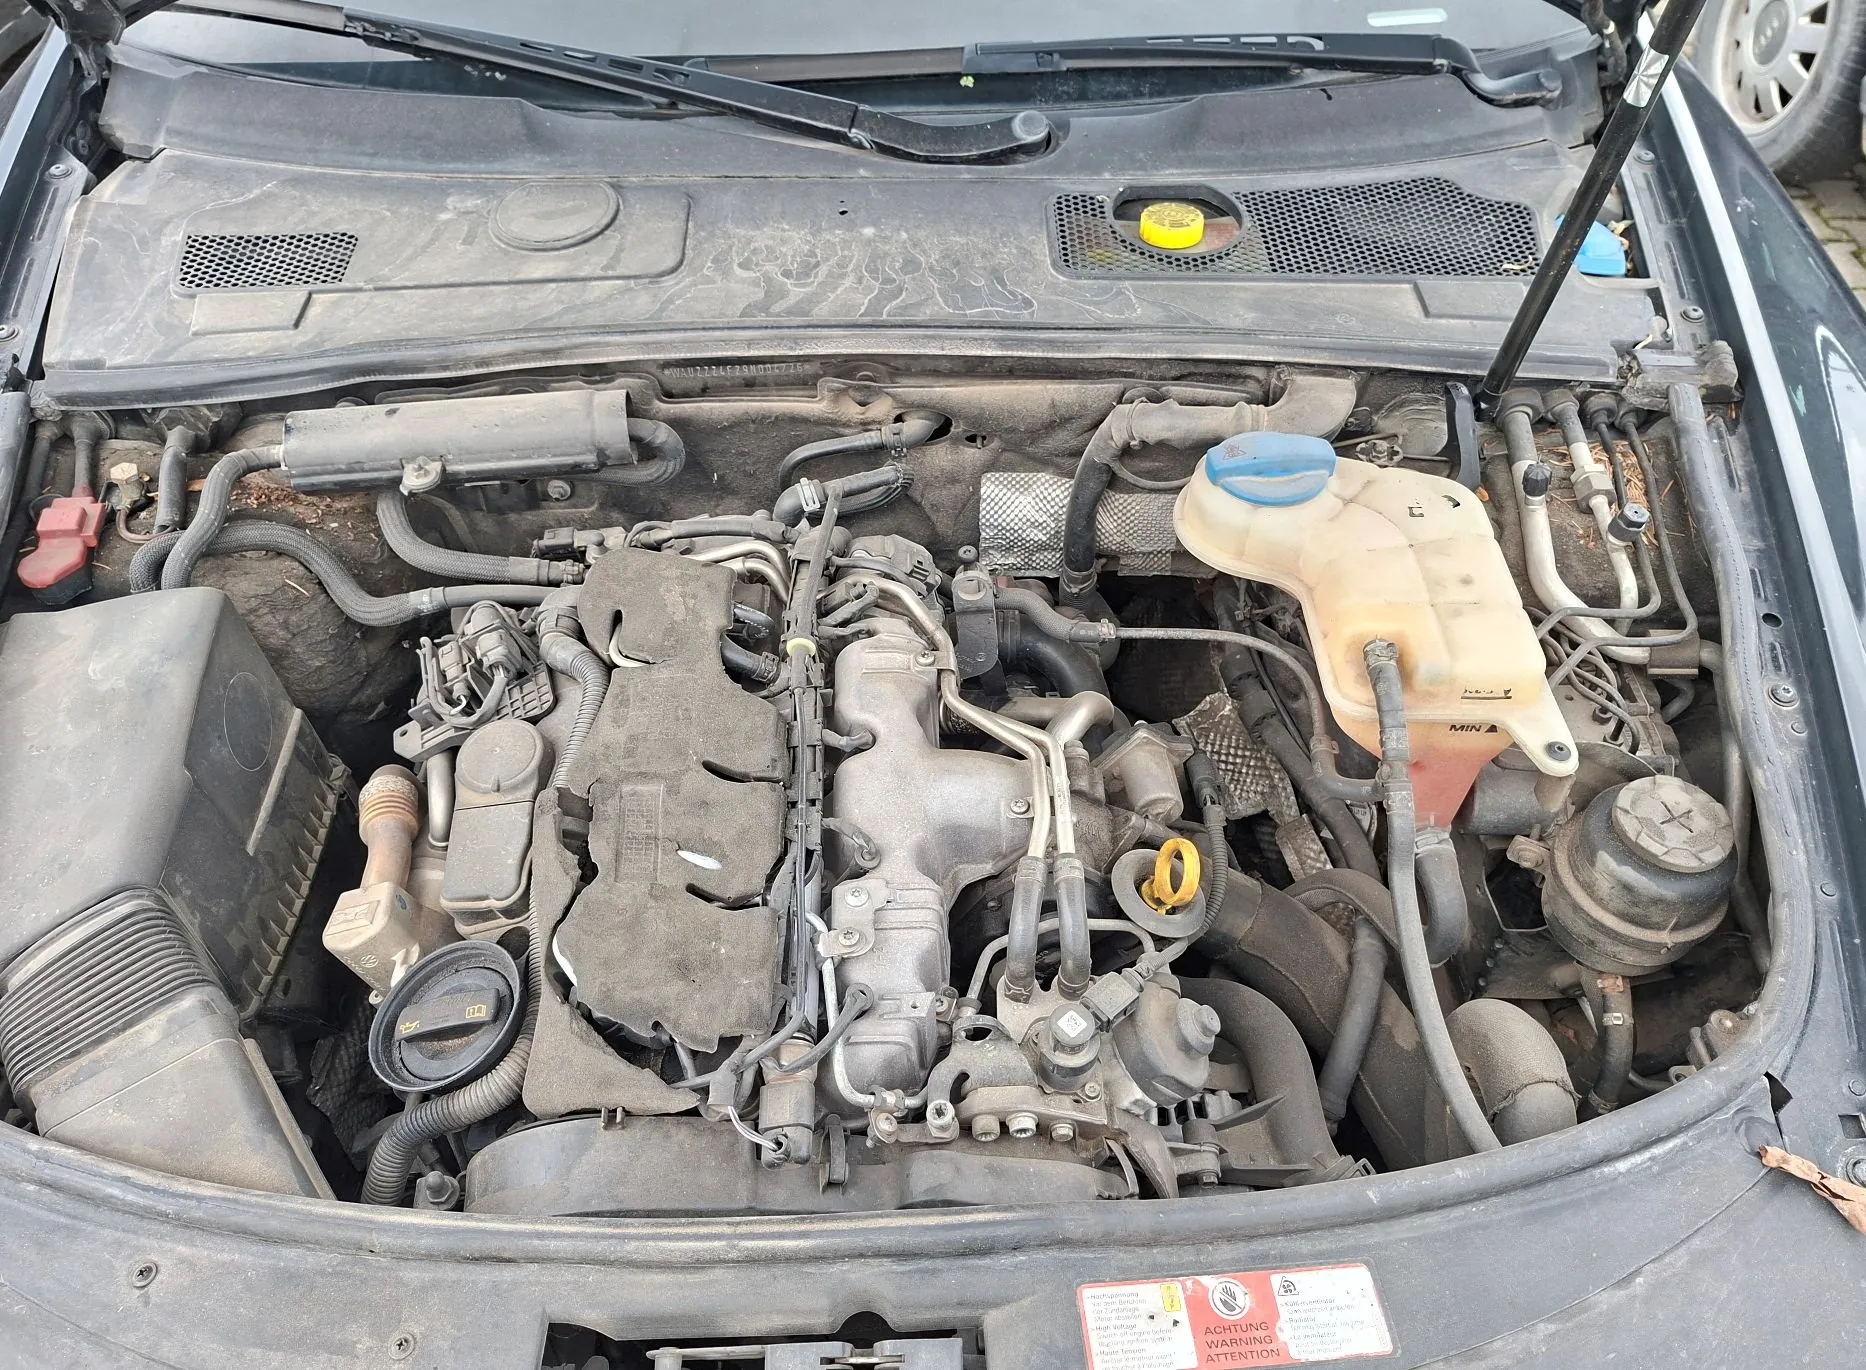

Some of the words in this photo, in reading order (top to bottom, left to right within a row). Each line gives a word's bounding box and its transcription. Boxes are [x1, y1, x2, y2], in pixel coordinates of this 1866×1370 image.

[1449, 724, 1482, 732] MIN
[1095, 1324, 1110, 1333] High
[1113, 1323, 1137, 1331] Voltage
[1204, 1321, 1269, 1336] ACHTUNG
[1205, 1335, 1273, 1349] WARNING
[1206, 1348, 1280, 1364] ATTENTION
